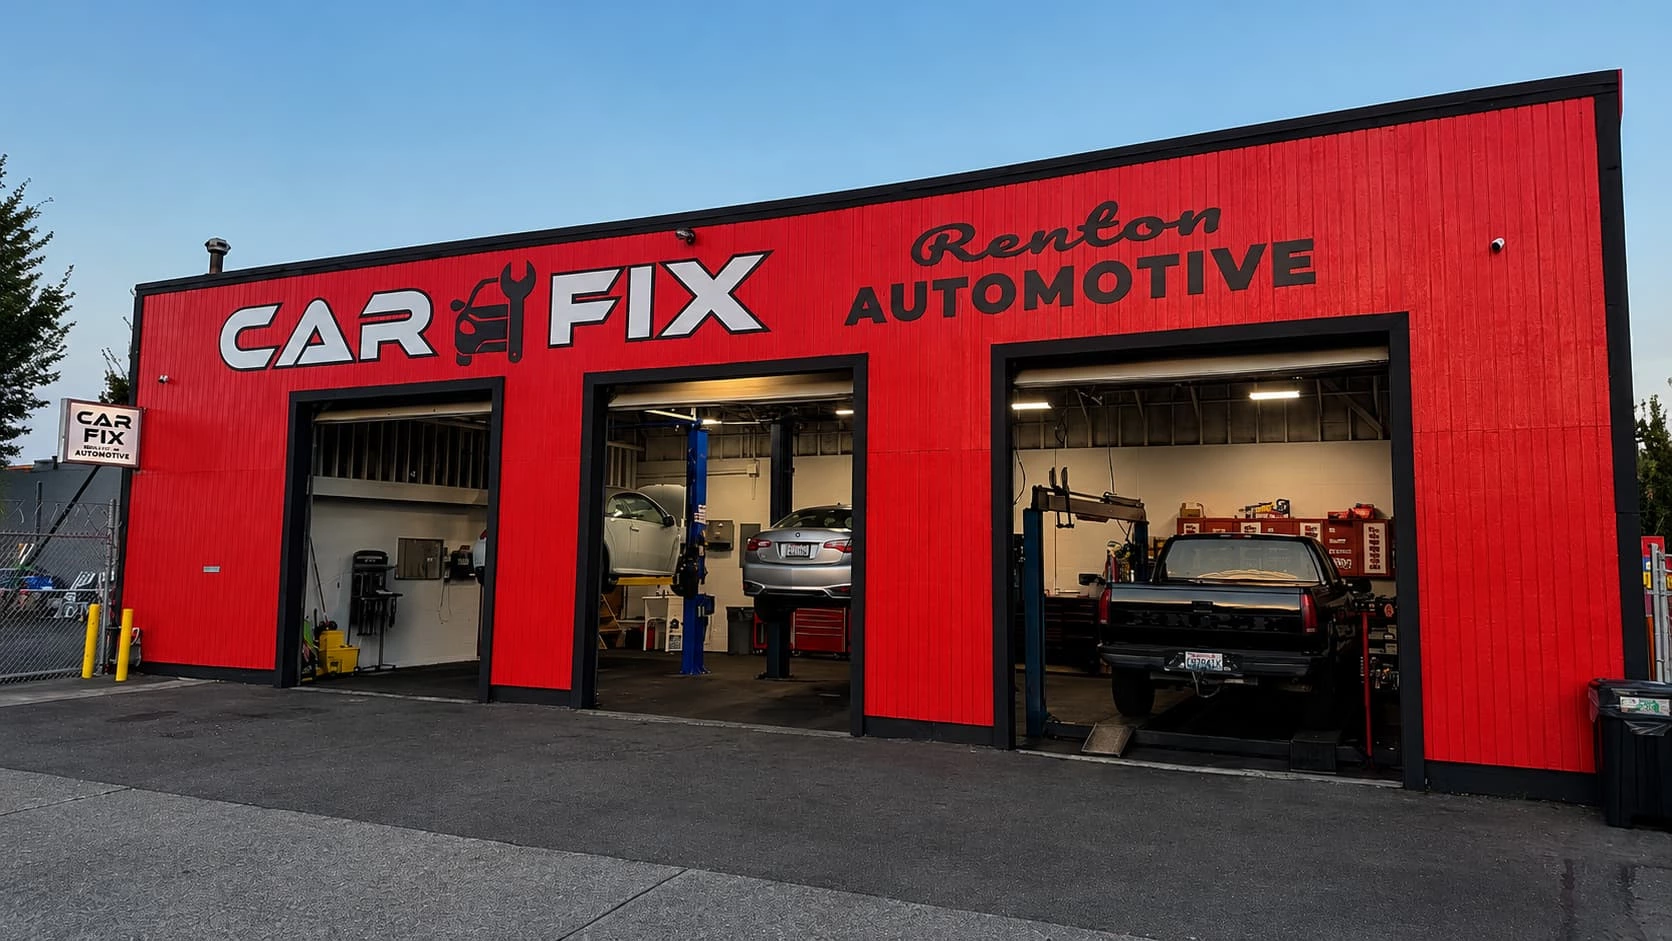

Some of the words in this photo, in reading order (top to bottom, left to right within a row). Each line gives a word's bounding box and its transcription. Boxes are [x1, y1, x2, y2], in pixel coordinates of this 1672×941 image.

[911, 200, 1221, 266] Renton
[844, 238, 1317, 326] AUTOMOTIVE
[219, 288, 439, 371] CAR
[548, 250, 775, 348] FIX
[77, 411, 132, 429] CAR
[84, 428, 125, 445] FIX
[75, 450, 129, 460] AUTOMOTIVE
